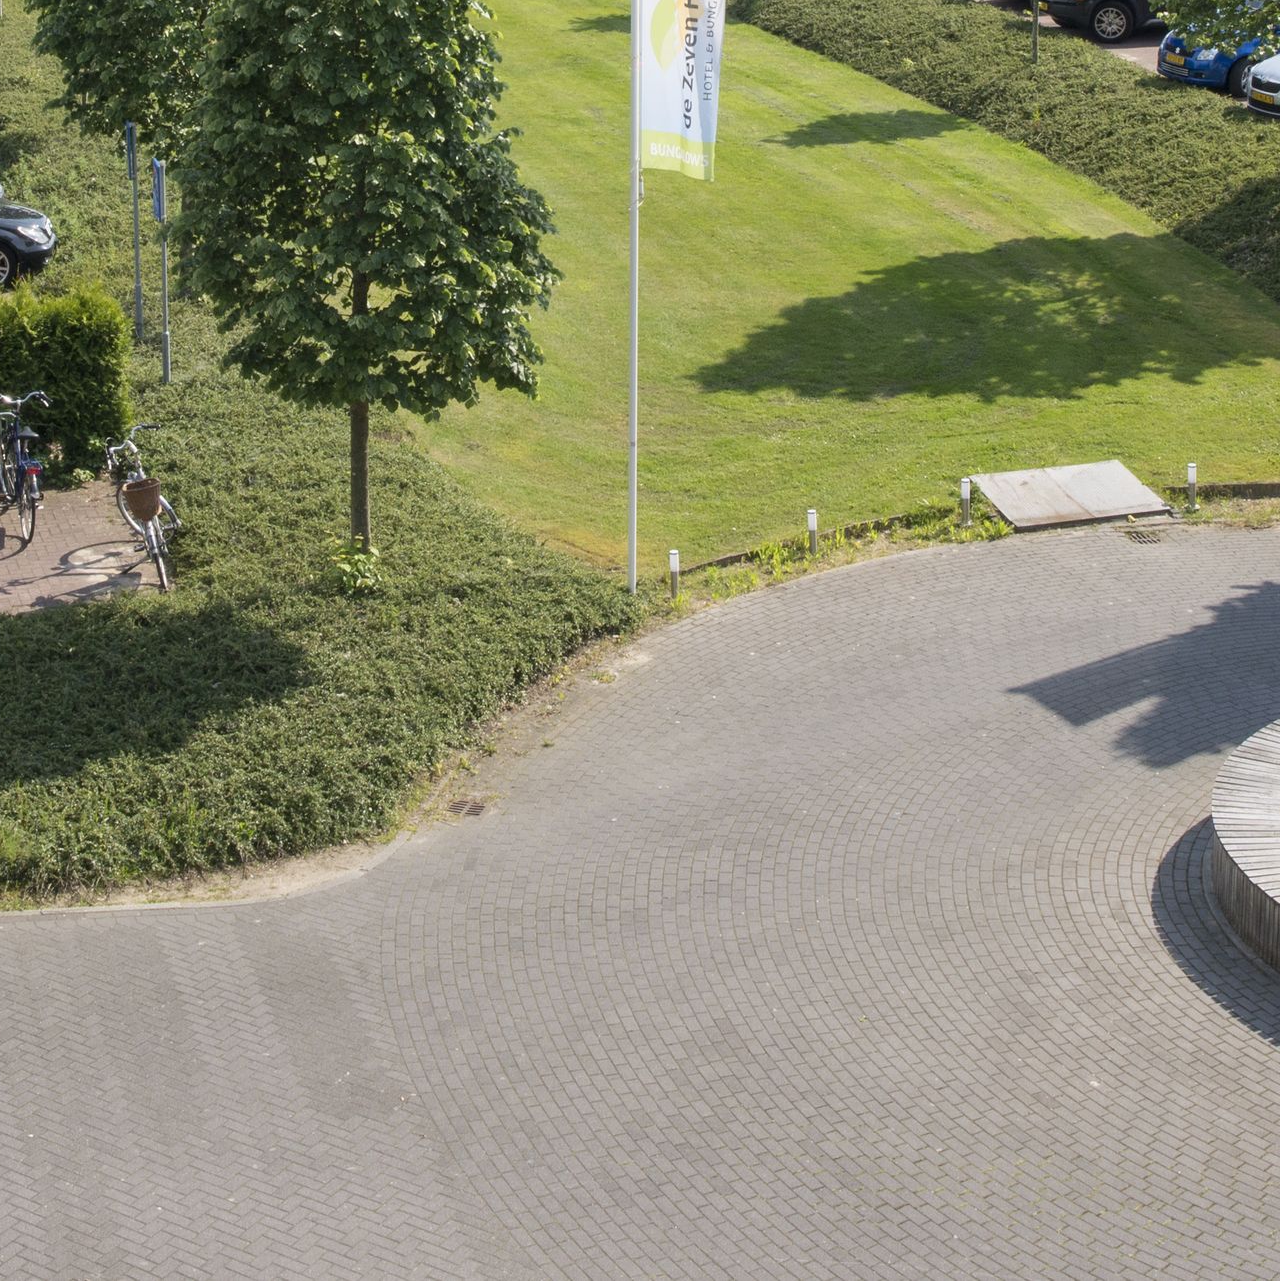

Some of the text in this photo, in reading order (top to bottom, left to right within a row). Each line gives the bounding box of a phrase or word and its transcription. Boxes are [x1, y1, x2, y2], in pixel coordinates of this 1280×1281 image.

[682, 17, 699, 92] Zeven
[706, 44, 713, 53] &
[703, 60, 713, 101] HOTEL
[683, 99, 692, 129] de
